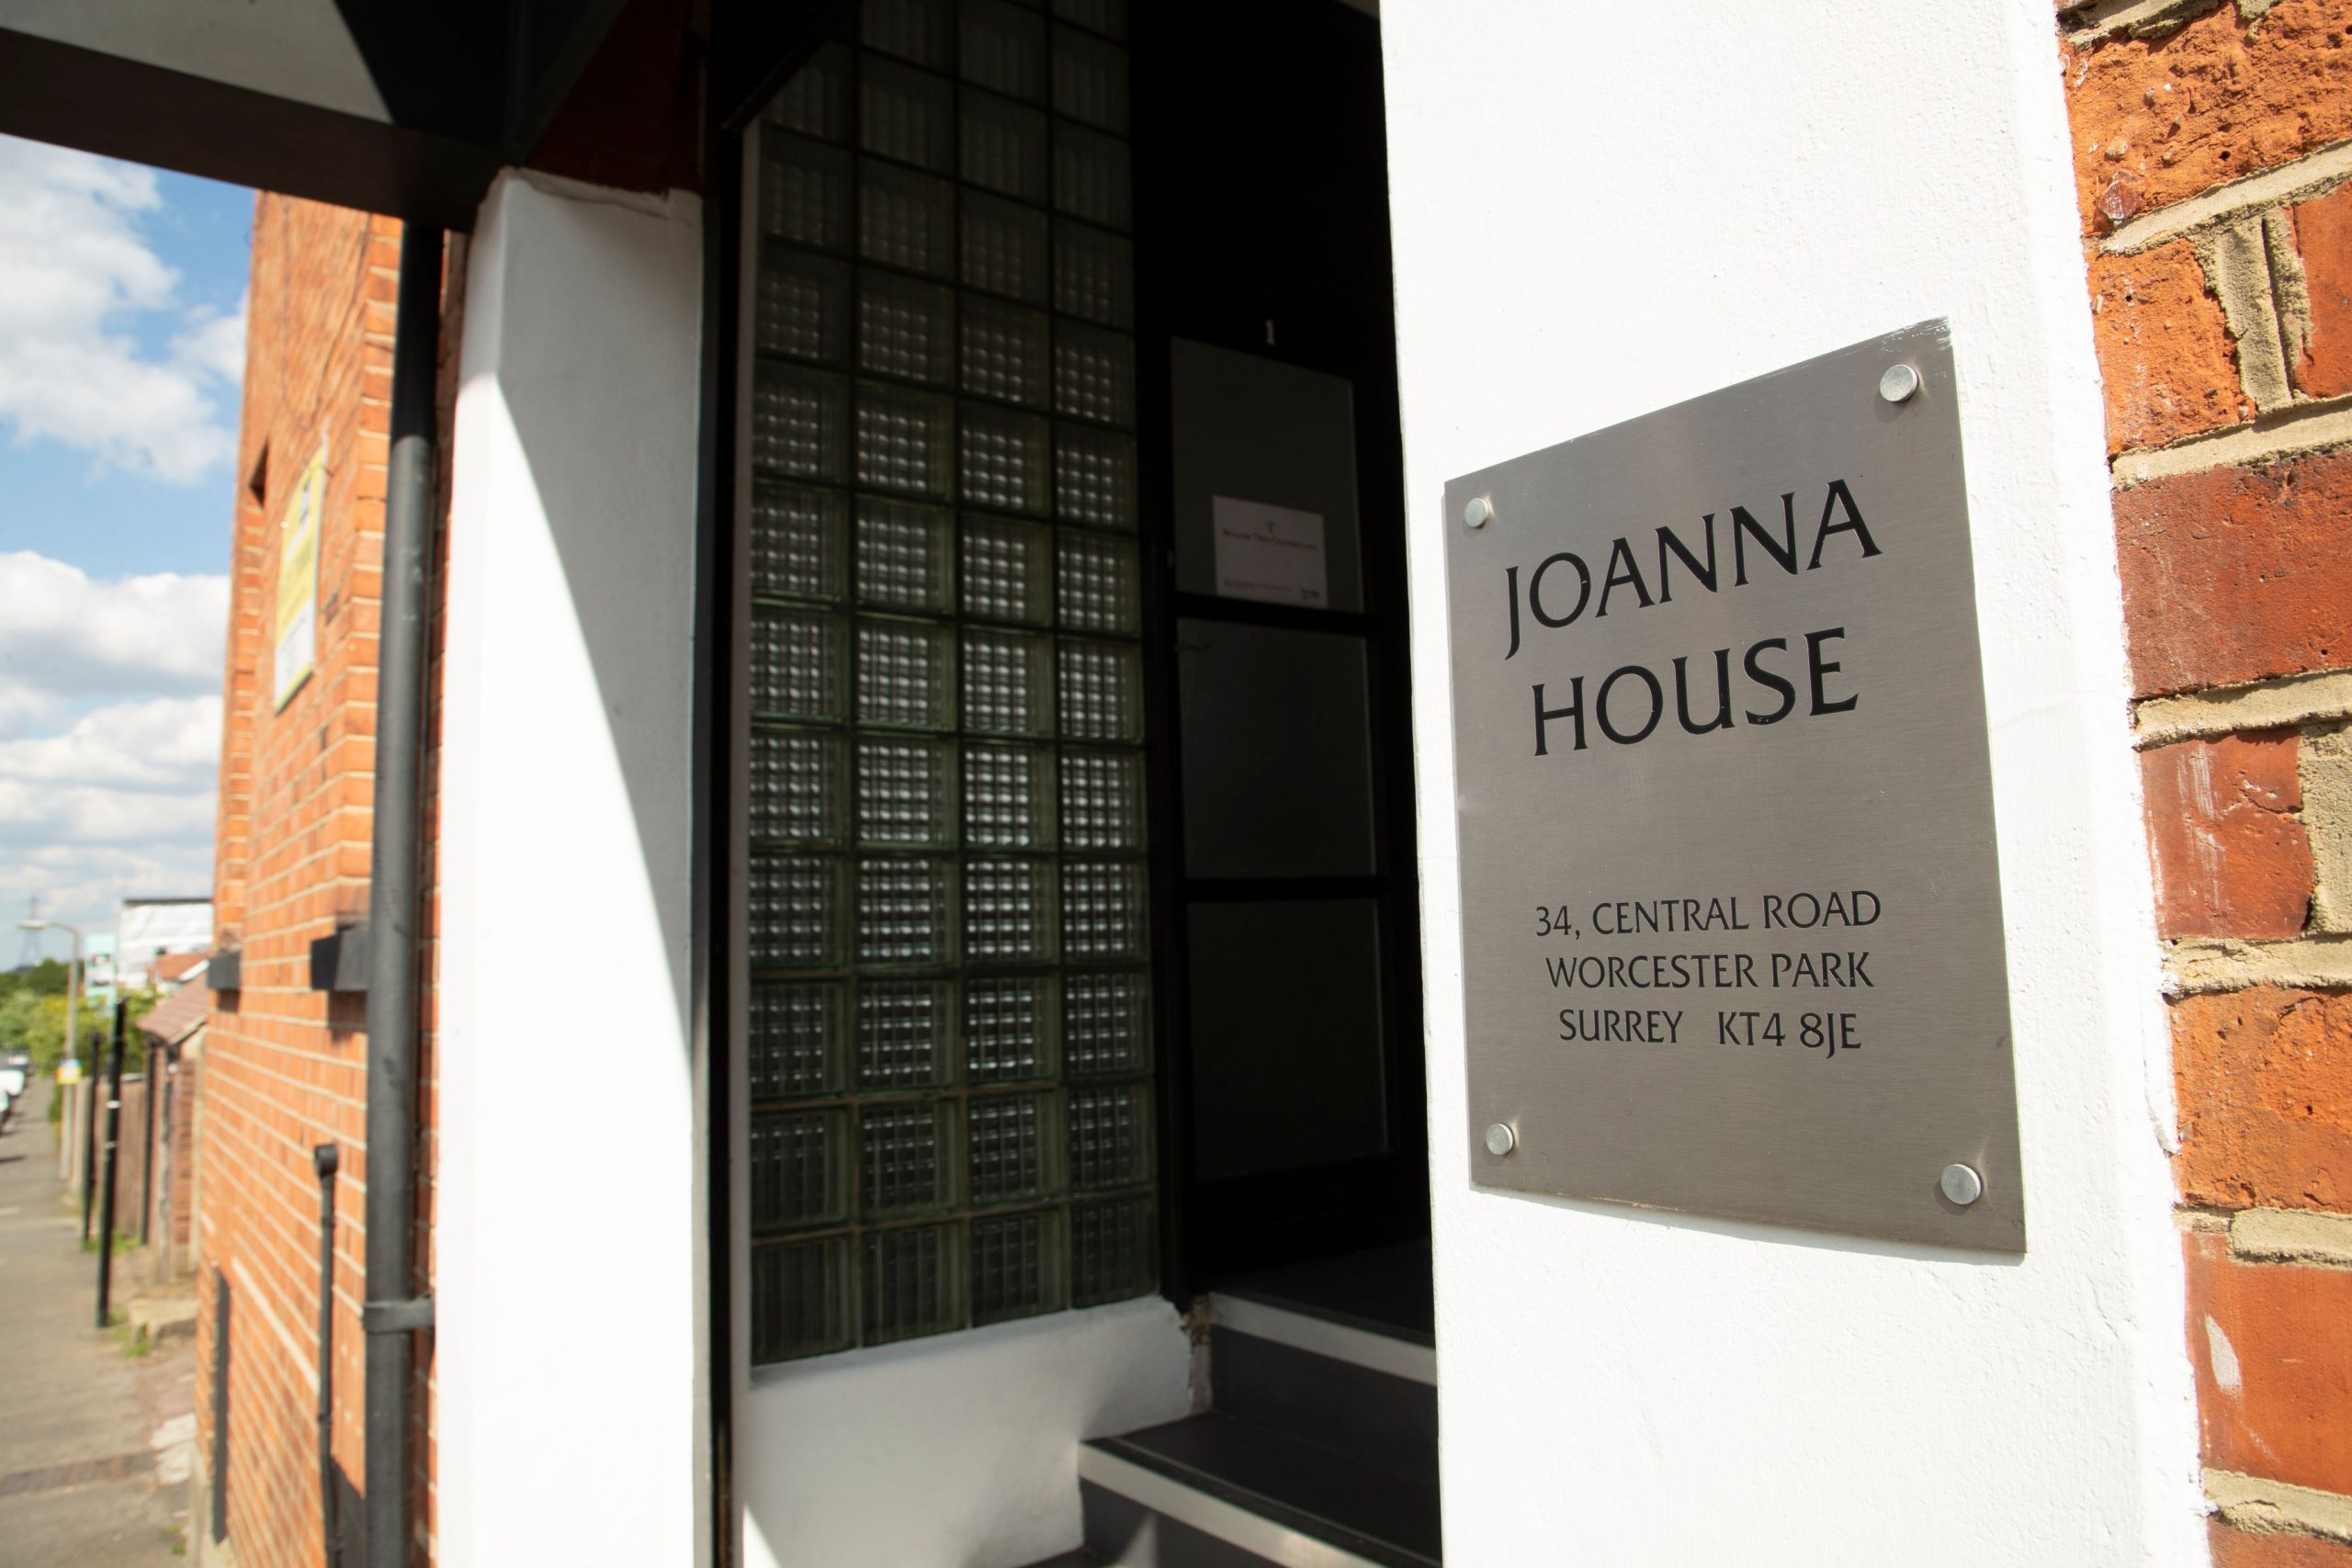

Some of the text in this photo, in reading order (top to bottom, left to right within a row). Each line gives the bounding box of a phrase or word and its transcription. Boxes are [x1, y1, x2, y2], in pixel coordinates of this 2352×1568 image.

[1504, 478, 1883, 661] JOANNA
[1530, 626, 1860, 757] HOUSE
[1535, 890, 1882, 940] 34, CENTRAL ROAD
[1545, 952, 1875, 989] WORCESTER PARK
[1558, 1009, 1862, 1059] SURREY KT4 8JE
